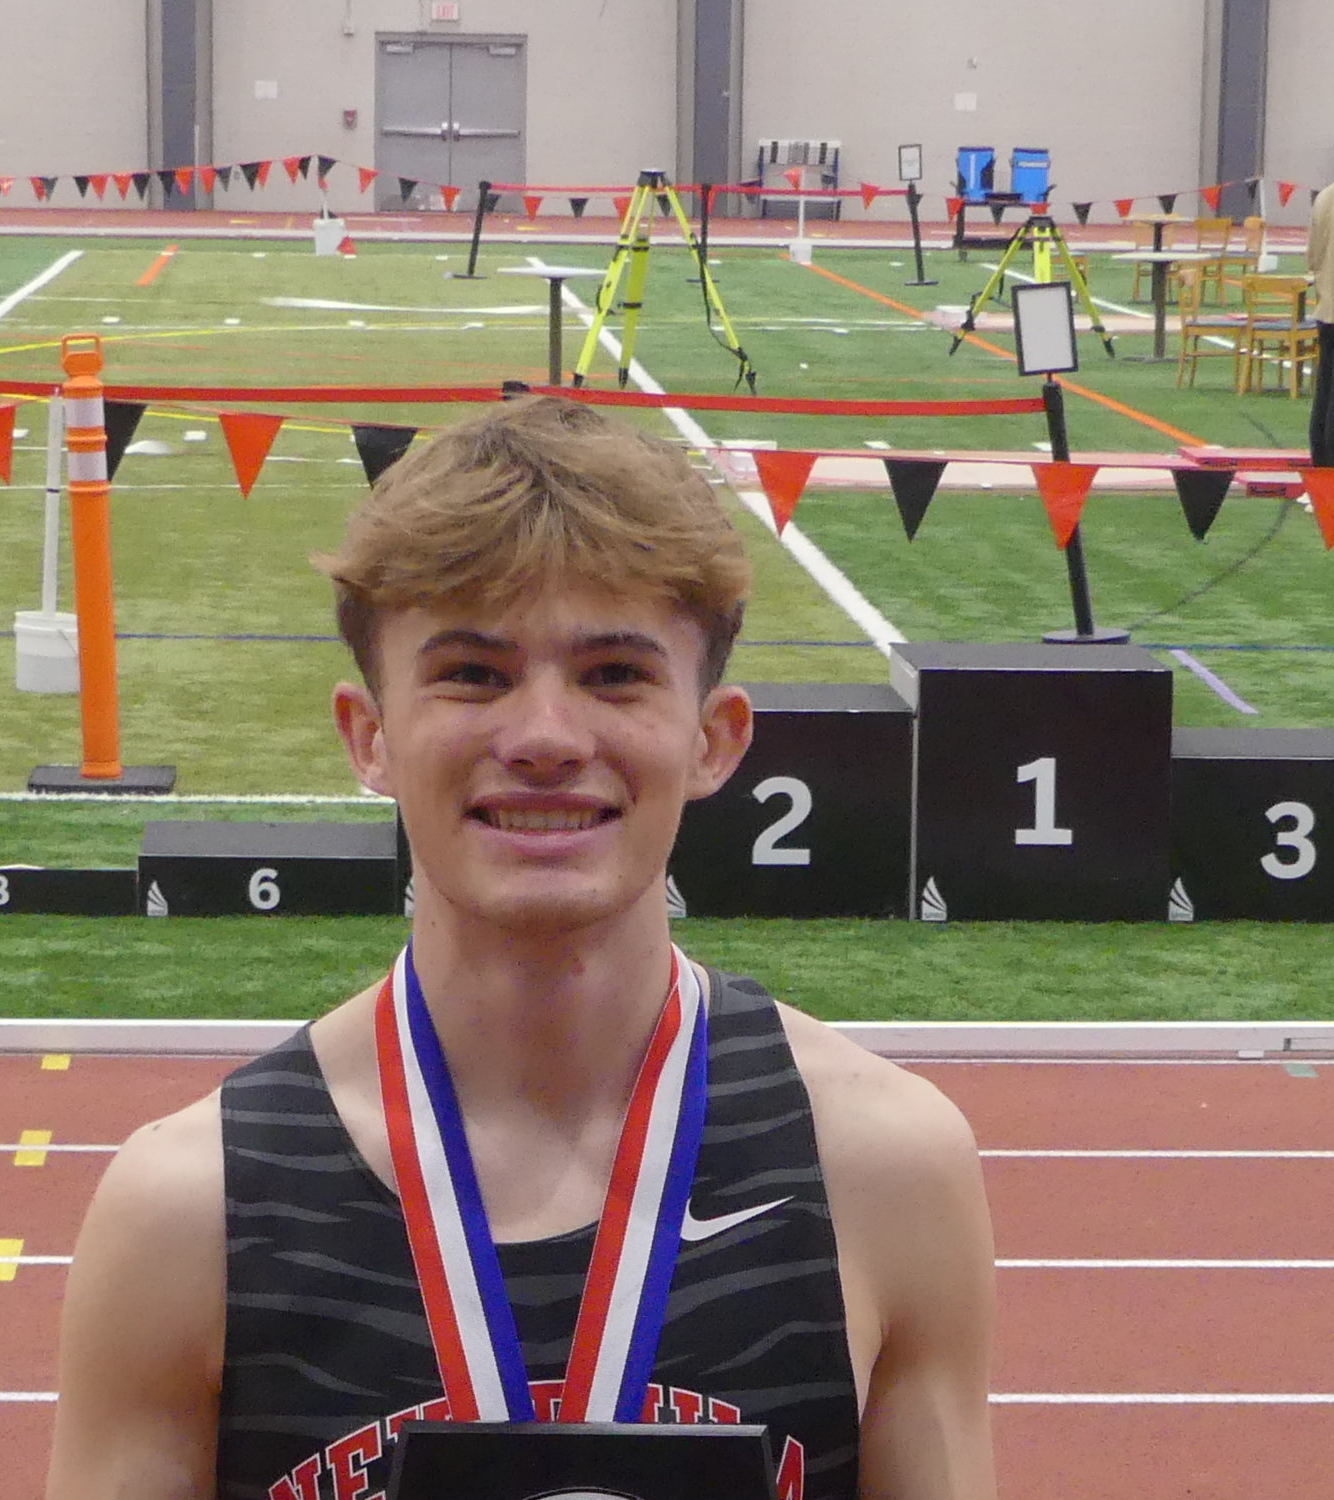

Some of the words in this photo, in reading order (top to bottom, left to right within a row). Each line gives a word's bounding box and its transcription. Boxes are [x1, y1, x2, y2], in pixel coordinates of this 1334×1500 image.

[751, 776, 813, 866] 2
[1014, 757, 1073, 845] 1
[1260, 801, 1316, 879] 3
[248, 868, 281, 911] 6
